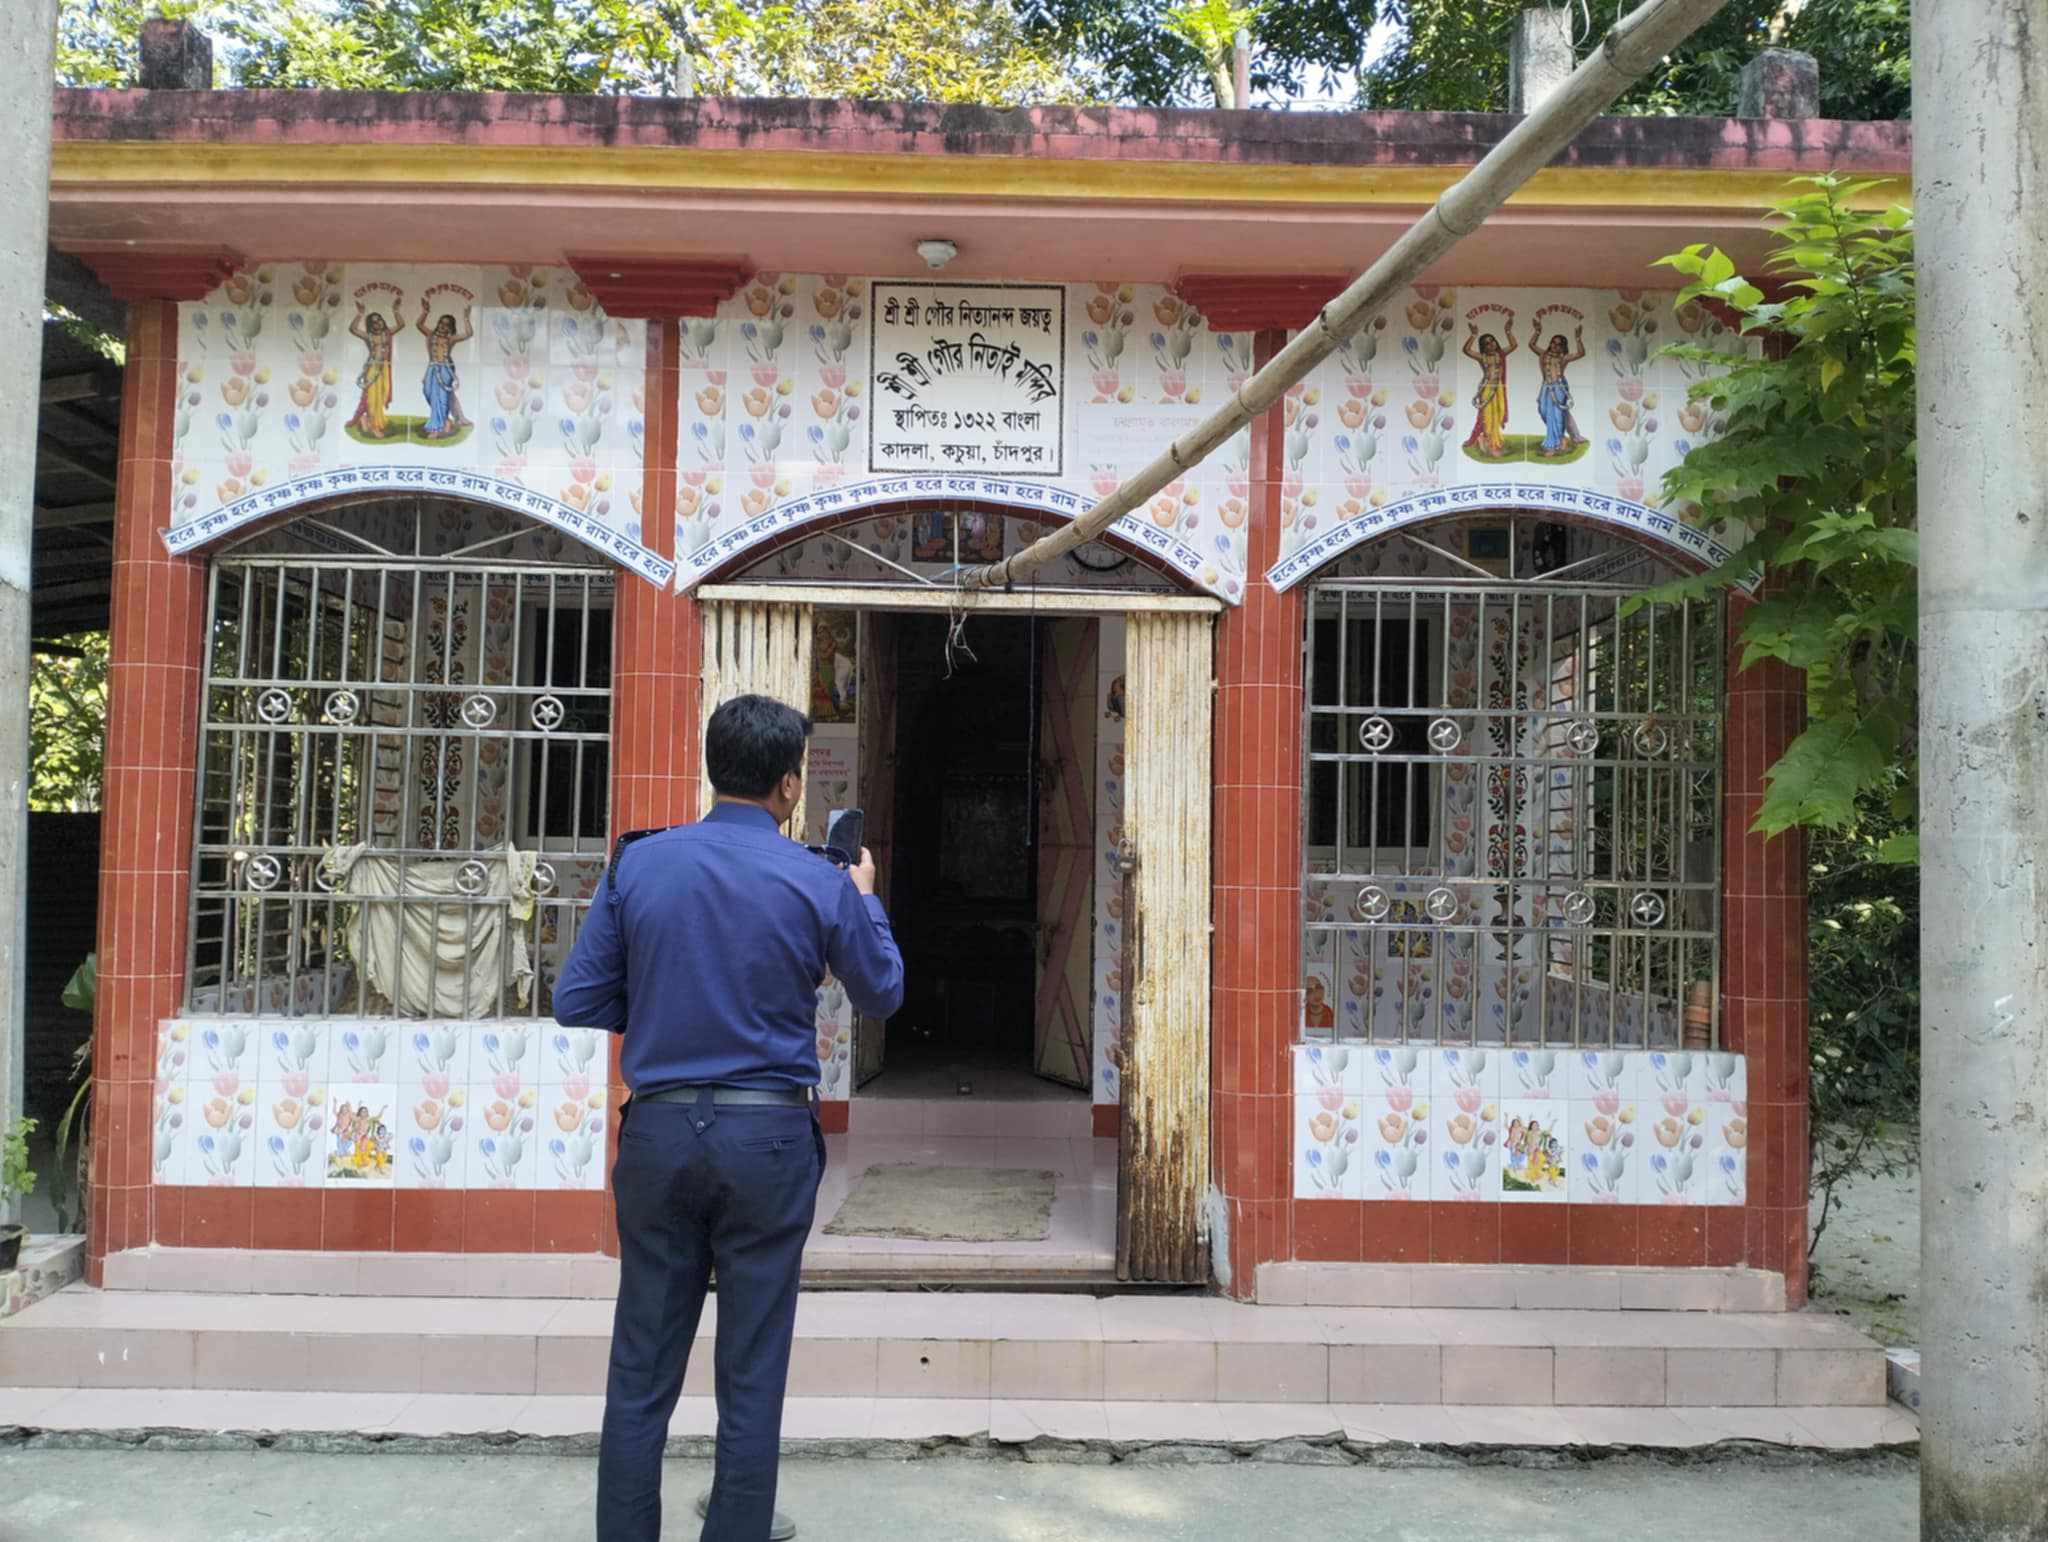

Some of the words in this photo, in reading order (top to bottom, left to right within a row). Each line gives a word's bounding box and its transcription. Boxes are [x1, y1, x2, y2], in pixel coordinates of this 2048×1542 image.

[883, 296, 899, 327] শ্রী
[904, 296, 920, 328] শ্রী
[925, 298, 954, 328] গৌর
[958, 299, 1015, 329] নিত্যানন্দ
[1019, 308, 1053, 336] জয়তু
[895, 352, 932, 387] শ্রী
[927, 336, 964, 375] গৌর
[968, 332, 1021, 382] নিতাই
[876, 372, 918, 400] শ্রী
[1015, 357, 1057, 405] মন্দির
[892, 403, 948, 432] স্থাপিতঃ
[954, 411, 997, 432] ১৩২২
[1002, 411, 1041, 432] বাংলা
[880, 441, 936, 464] কাদলা,
[940, 444, 988, 466] কচুয়া,
[169, 527, 195, 544] হরে
[231, 498, 258, 517] হরে
[361, 470, 389, 483] হরে
[395, 470, 423, 483] হরে
[429, 472, 456, 486] হরে
[462, 477, 490, 492] রাম
[495, 484, 522, 503] হরে
[526, 494, 554, 514] রাম
[557, 509, 583, 529] রাম
[585, 521, 612, 542] রাম
[614, 538, 640, 561] হরে
[642, 556, 670, 580] হরে
[693, 546, 719, 567] হরে
[751, 515, 778, 533] হরে
[881, 481, 908, 495] হরে
[914, 479, 942, 492] হরে
[947, 480, 976, 493] হরে
[982, 481, 1010, 496] রাম
[1015, 486, 1044, 500] হরে
[1049, 492, 1077, 509] রাম
[1142, 527, 1169, 549] হরে
[1174, 546, 1200, 570] হরে
[1271, 562, 1298, 583] হরে
[1326, 528, 1352, 547] হরে
[1451, 489, 1478, 503] হরে
[1484, 488, 1511, 500] হরে
[1517, 488, 1545, 501] হরে
[1551, 490, 1577, 504] রাম
[1582, 494, 1611, 512] হরে
[1616, 503, 1642, 520] রাম
[1647, 514, 1674, 533] রাম
[1678, 529, 1705, 549] রাম
